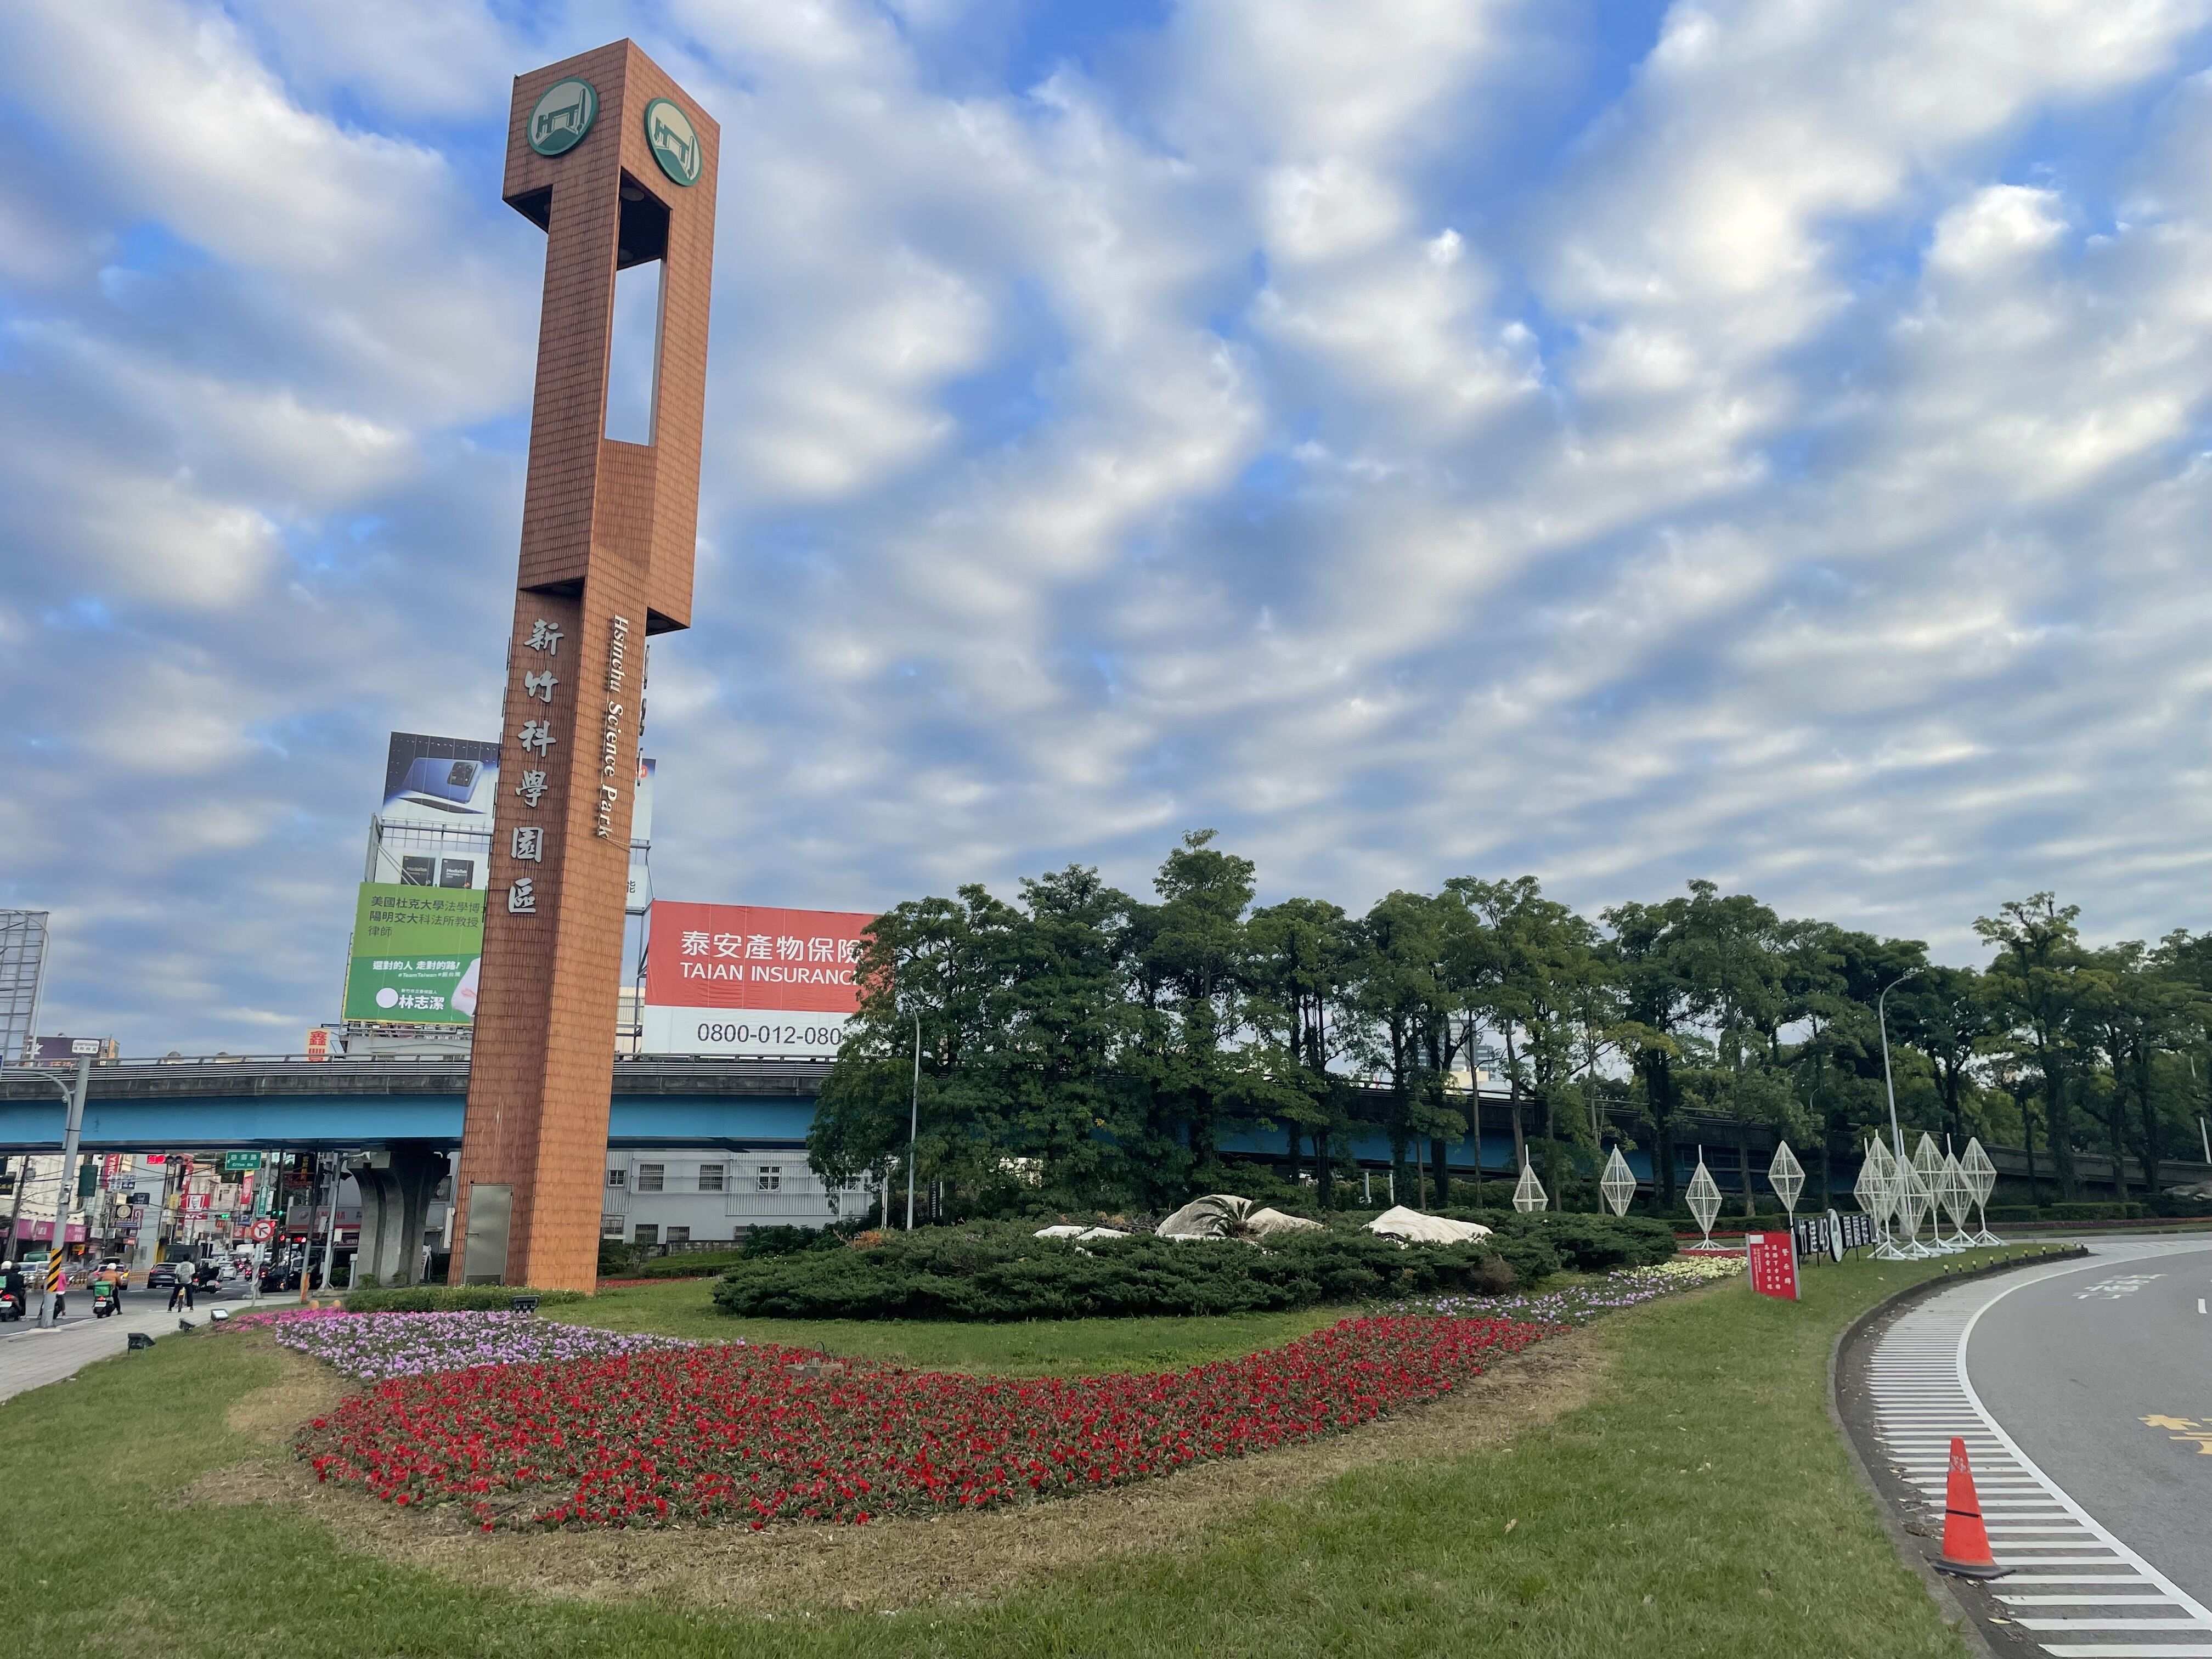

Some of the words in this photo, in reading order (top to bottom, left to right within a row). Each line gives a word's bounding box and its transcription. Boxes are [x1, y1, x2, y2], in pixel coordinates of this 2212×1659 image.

[610, 614, 629, 693] Hsinchu
[604, 701, 623, 777] Science
[508, 618, 565, 914] 新竹科學園區
[597, 783, 617, 838] Park
[369, 911, 479, 928] 陽明交大科法所教授
[368, 926, 392, 938] 律師
[681, 930, 861, 964] 泰安產物保險
[373, 961, 413, 970] 選對的人
[680, 962, 743, 981] TAIAN
[398, 995, 445, 1011] 林志潔
[697, 1023, 842, 1045] 0800-012-080
